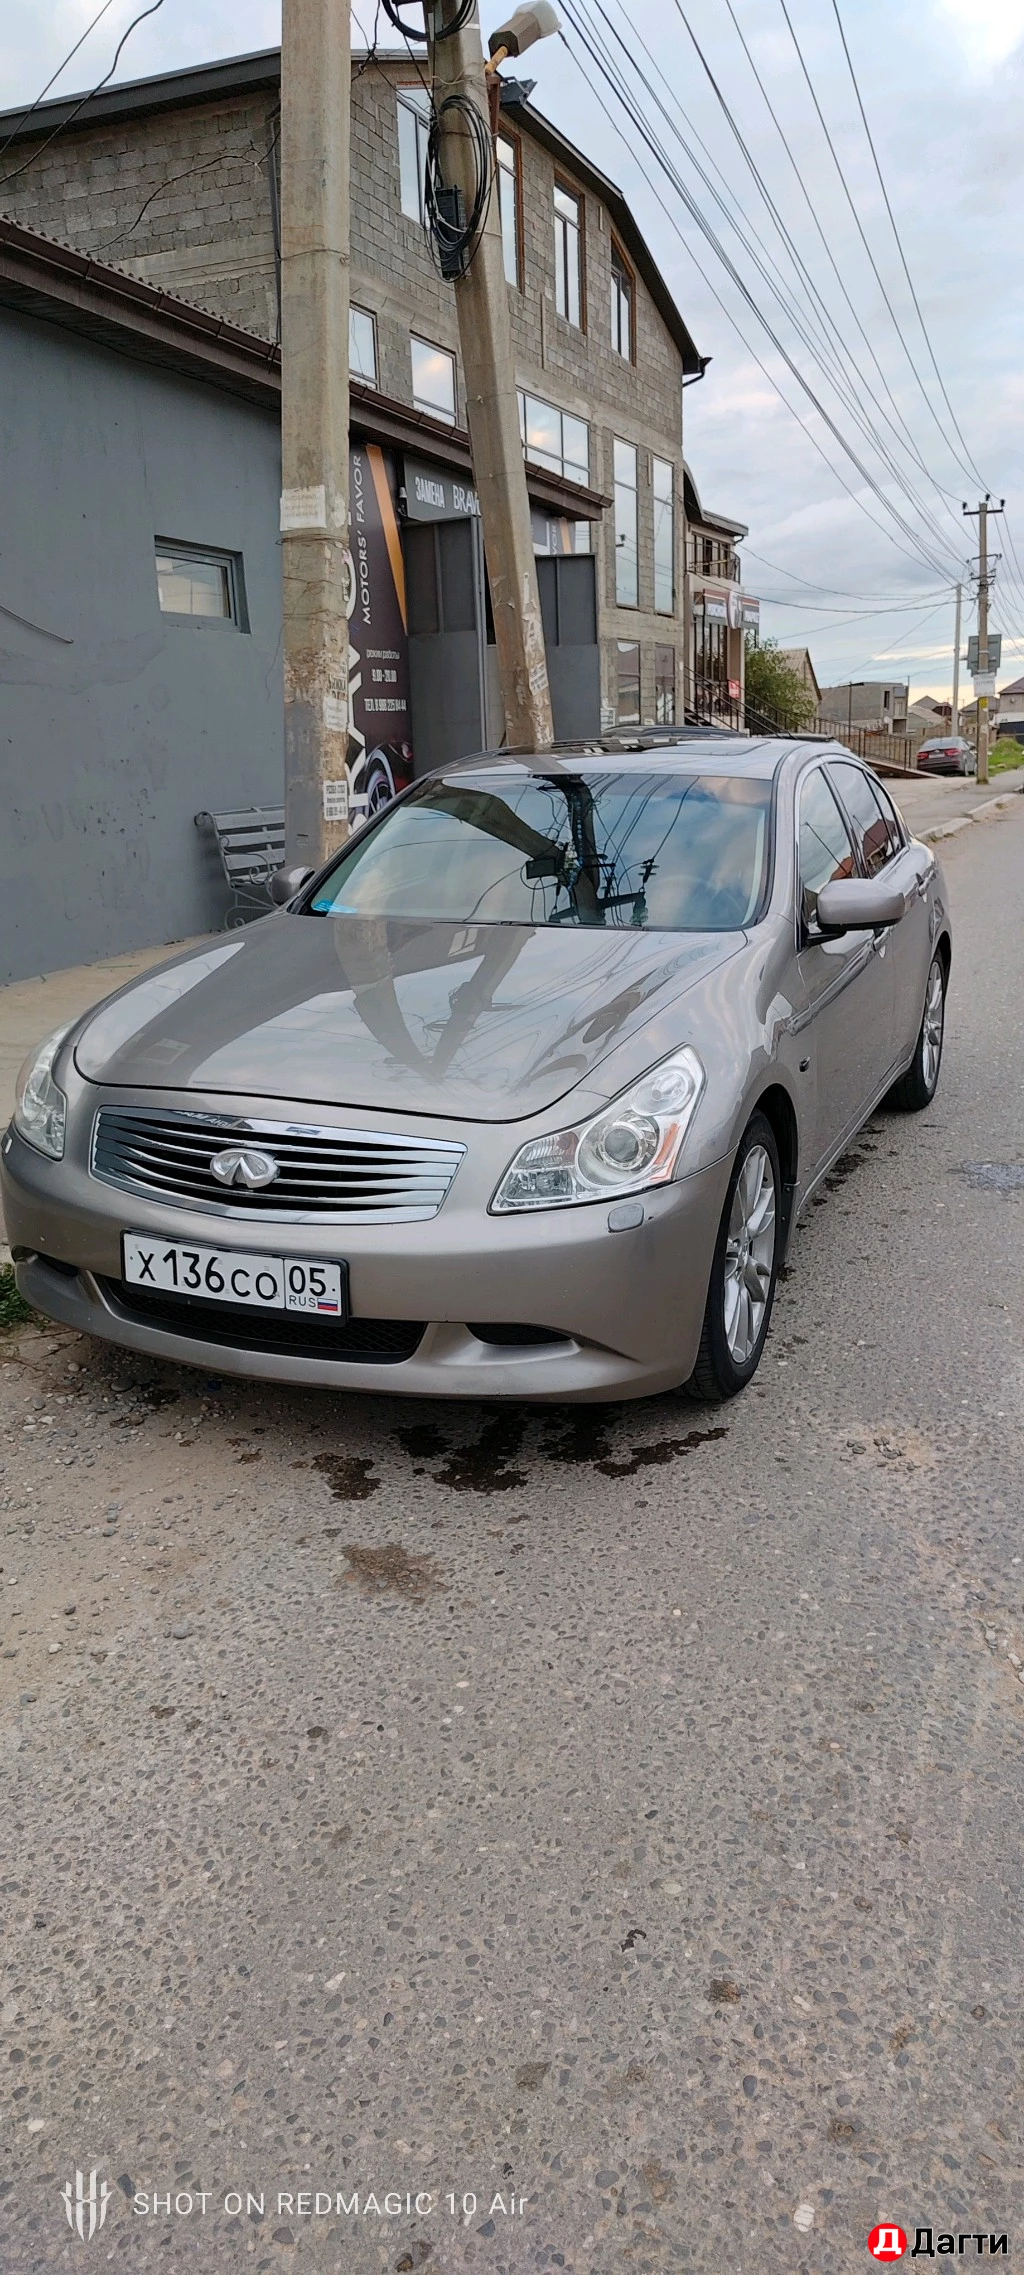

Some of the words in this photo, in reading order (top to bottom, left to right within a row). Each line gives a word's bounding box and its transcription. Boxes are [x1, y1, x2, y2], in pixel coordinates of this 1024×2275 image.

[353, 455, 365, 523] FAVOR
[415, 476, 446, 509] ЗАМЕНА
[452, 484, 482, 516] BRAV
[288, 1265, 327, 1297] 05
[288, 1295, 317, 1308] RUS
